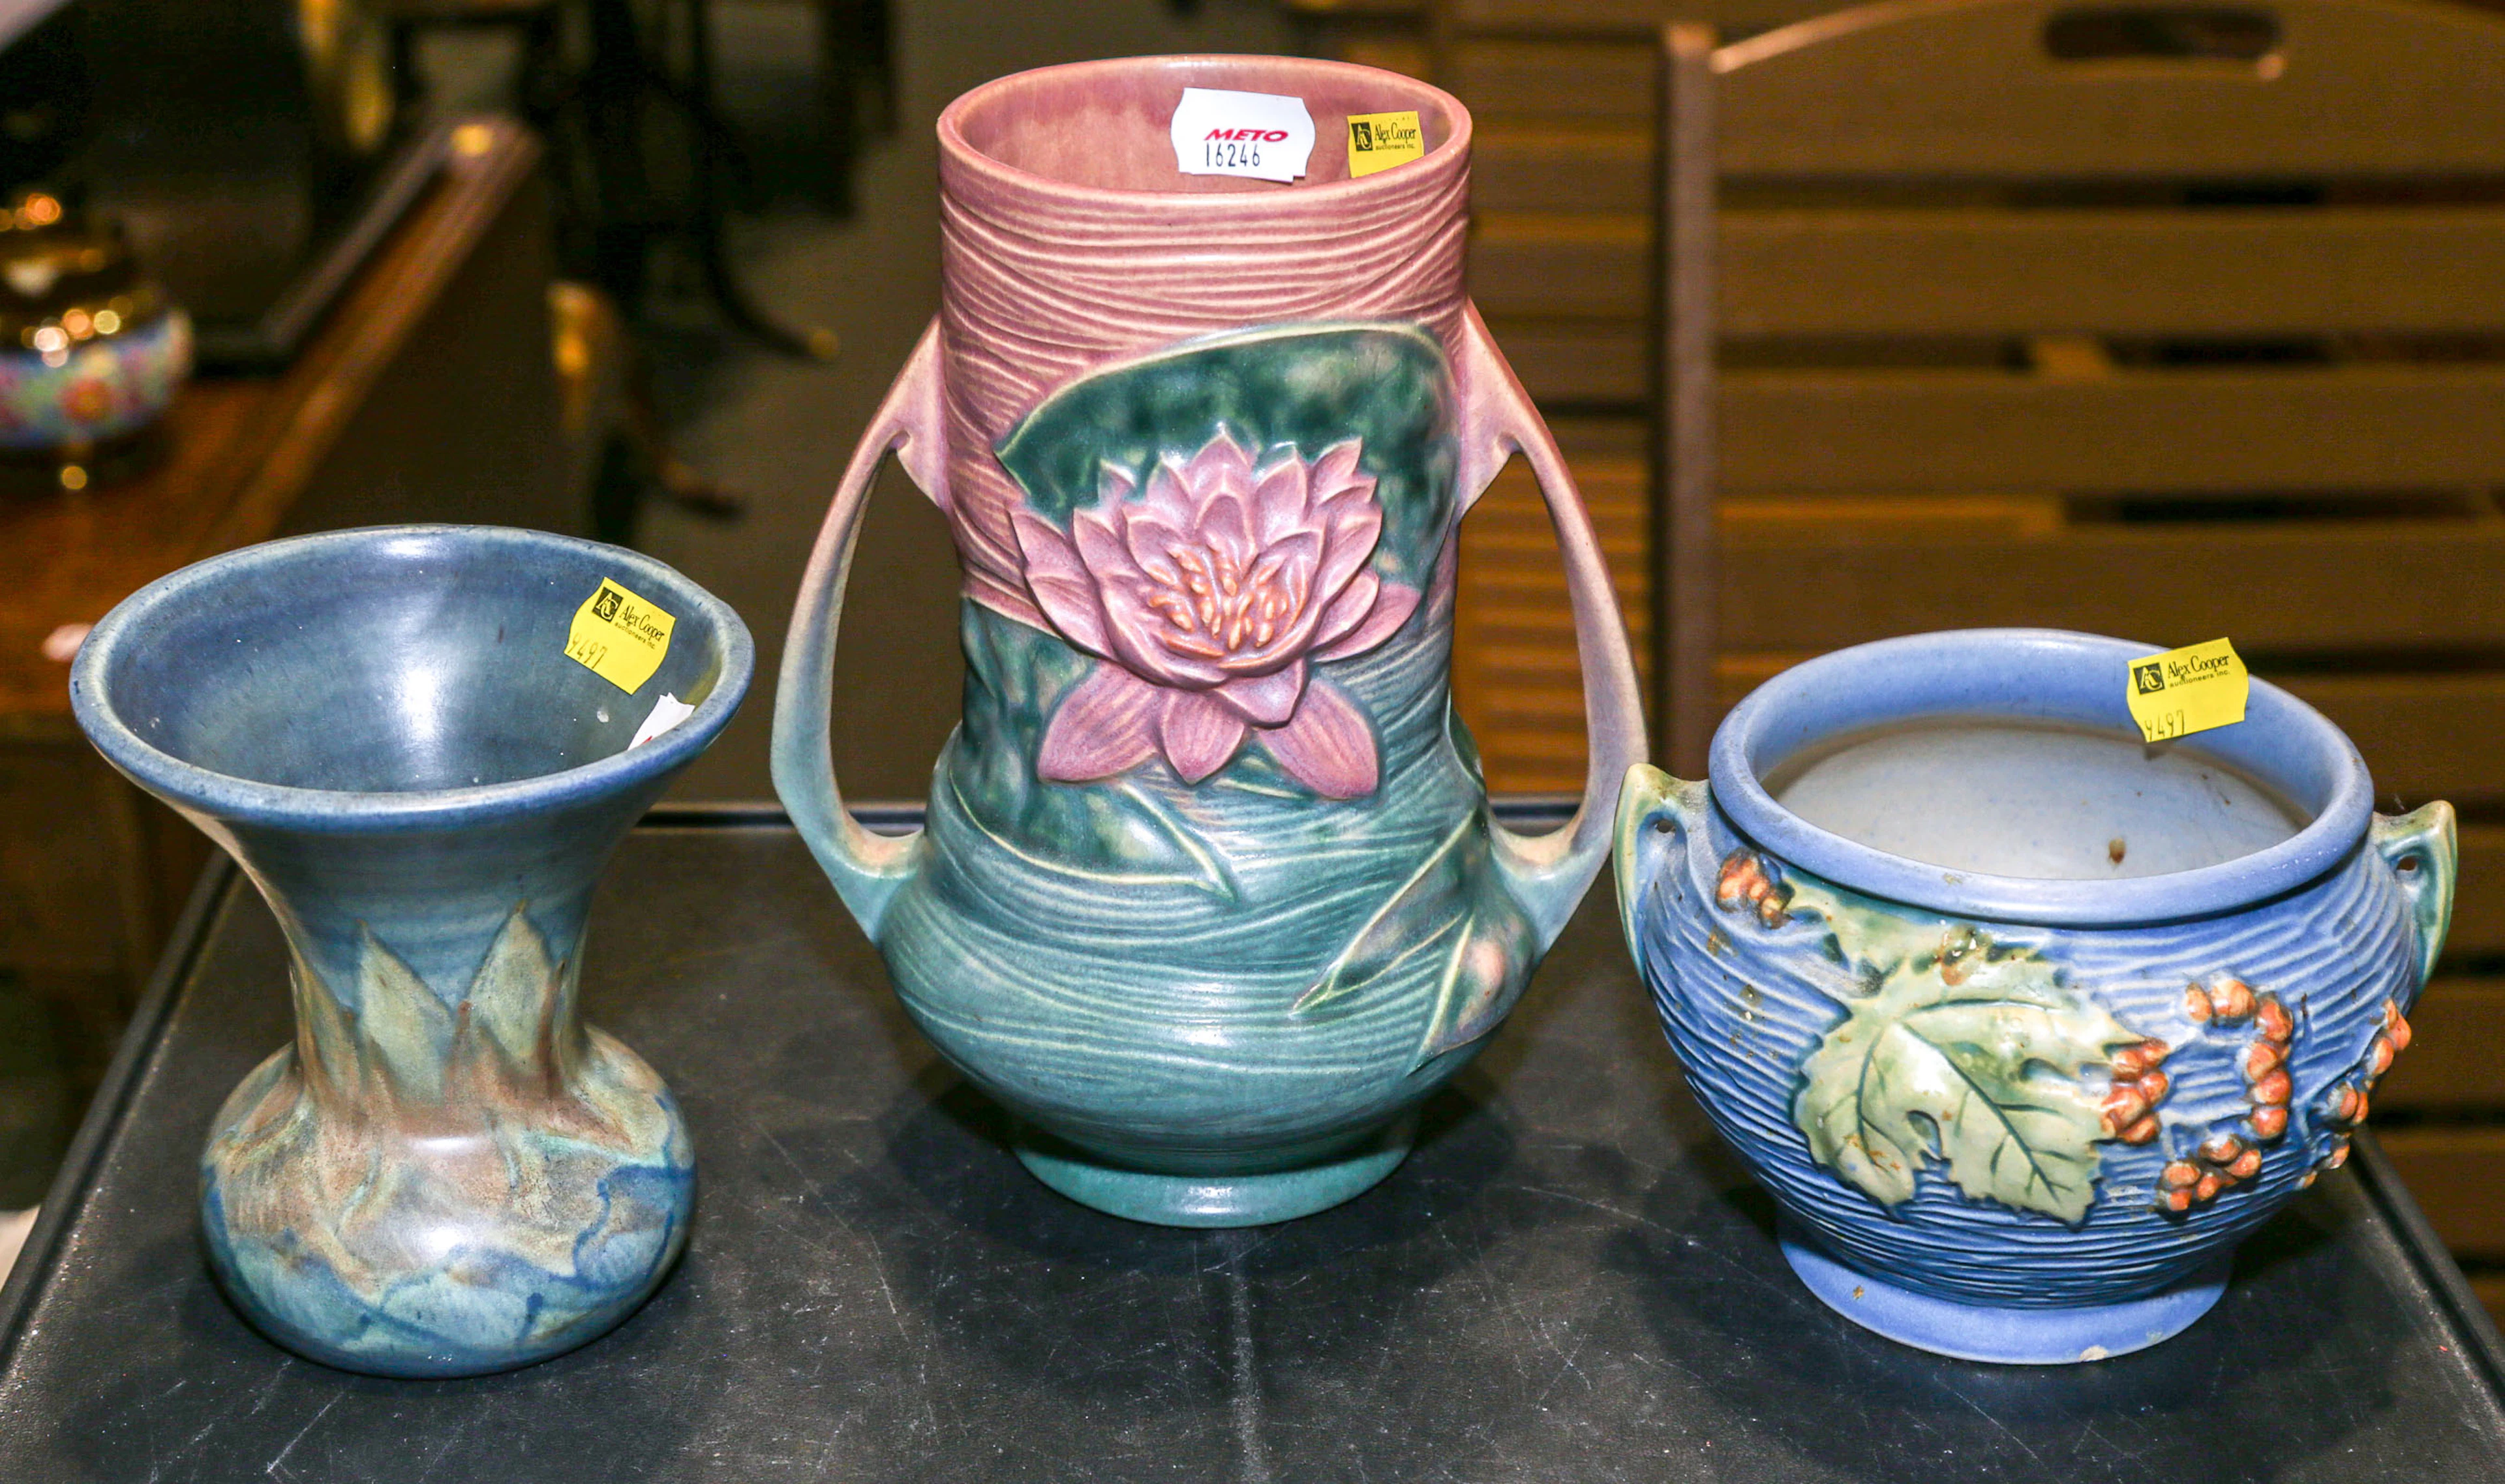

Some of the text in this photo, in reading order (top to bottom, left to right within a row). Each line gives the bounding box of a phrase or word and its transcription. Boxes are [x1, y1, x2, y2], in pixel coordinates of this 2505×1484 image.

[1204, 129, 1288, 142] METO
[1374, 122, 1416, 144] Alex Cooper
[1206, 143, 1260, 167] 16246
[615, 622, 646, 644] auctioneers
[619, 605, 665, 642] Alex Cooper
[2168, 655, 2229, 678] Alex Cooper
[2169, 674, 2214, 688] auctioneers
